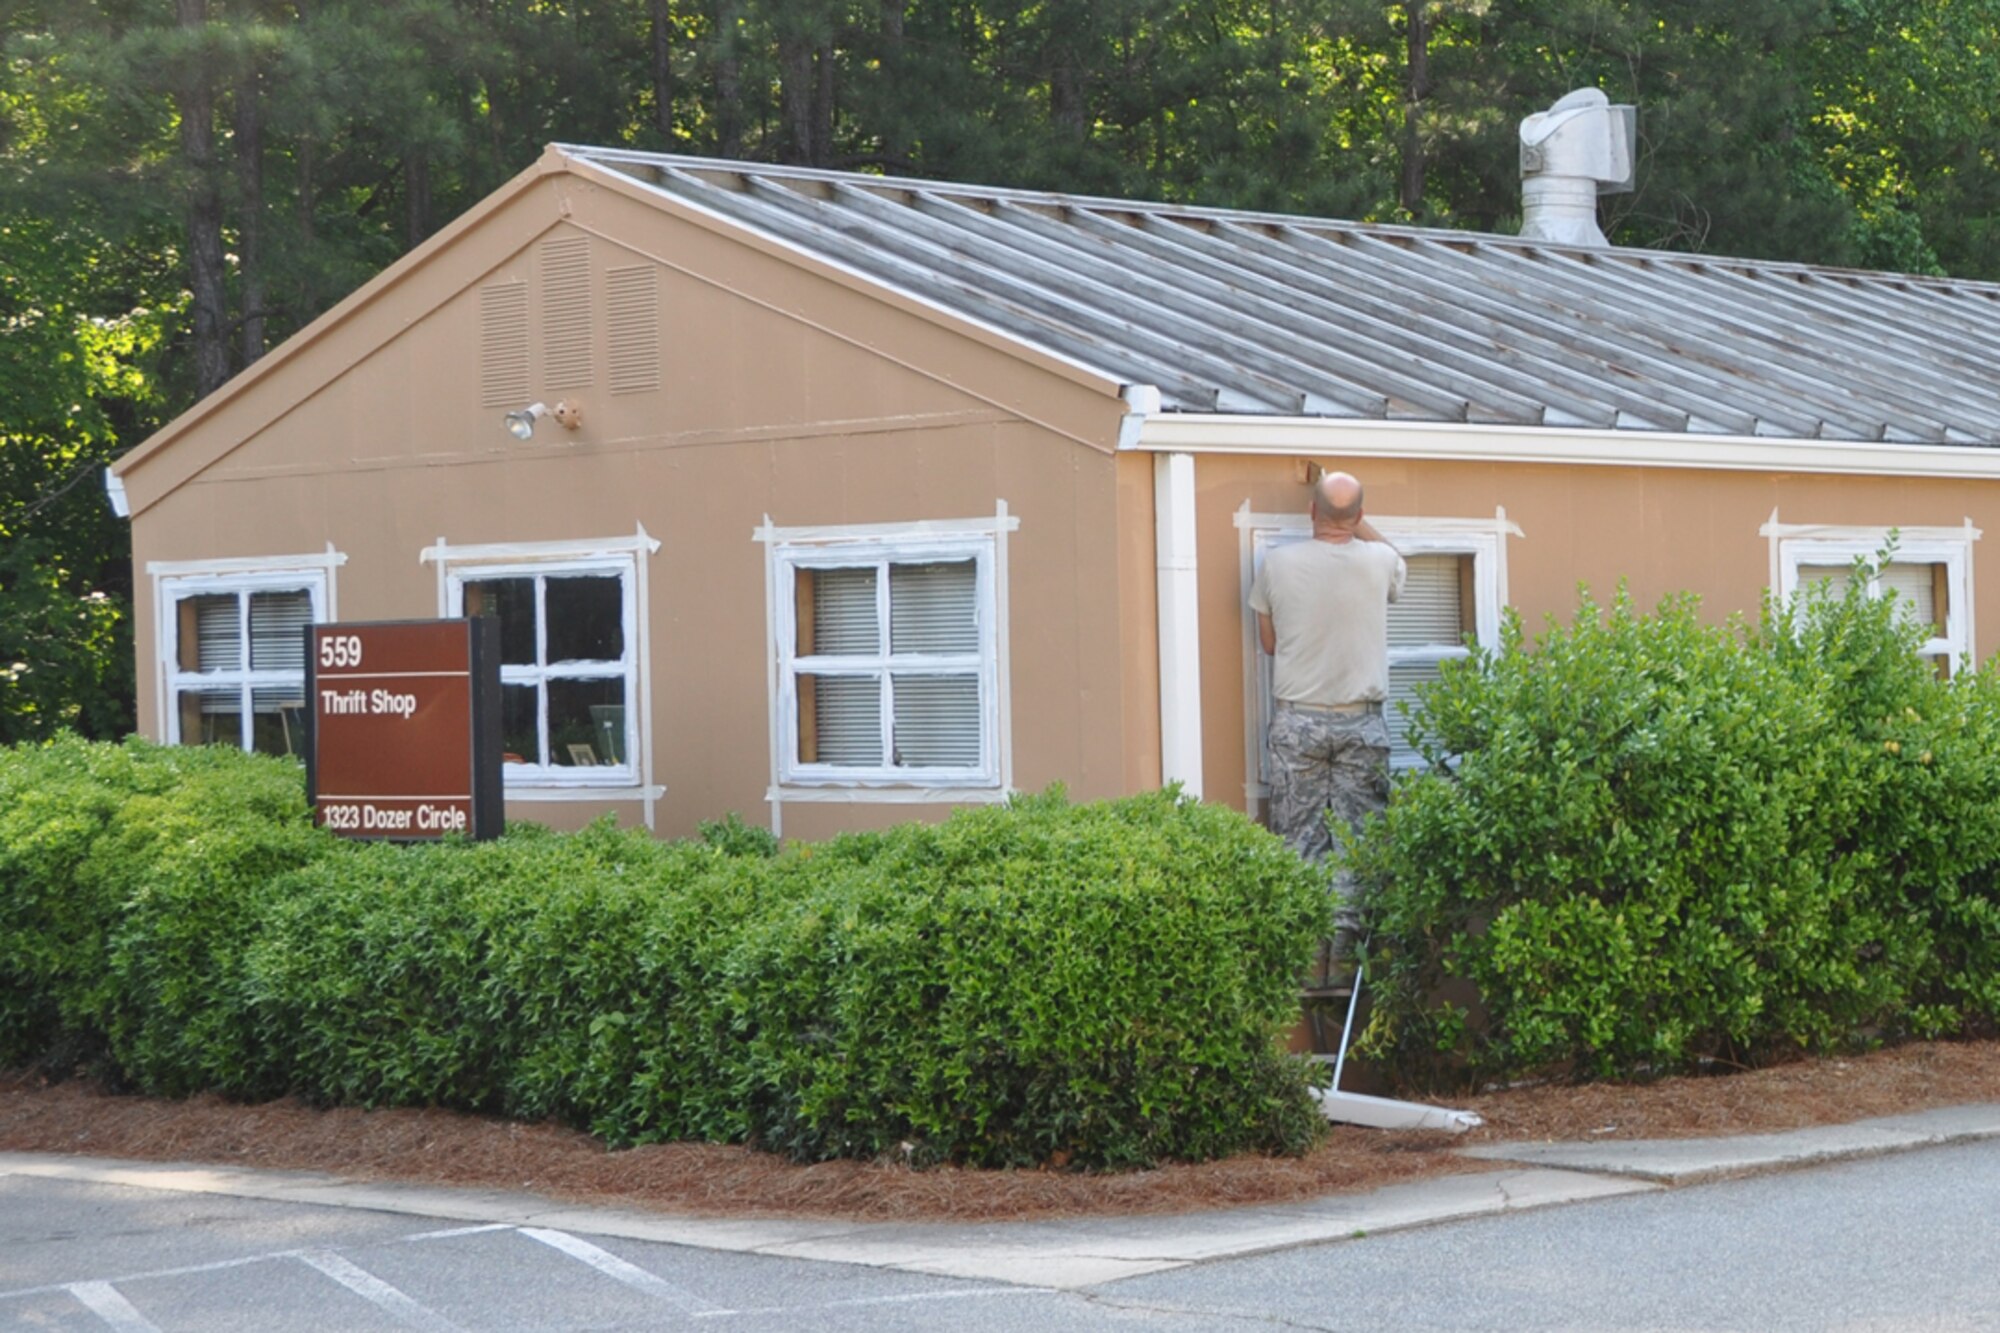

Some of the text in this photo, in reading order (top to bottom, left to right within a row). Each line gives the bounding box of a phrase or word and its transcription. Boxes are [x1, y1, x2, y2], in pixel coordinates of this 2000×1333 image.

[320, 636, 362, 666] 559
[321, 690, 415, 718] Thrift Shop
[323, 805, 465, 829] 1323 Dozer Circle
